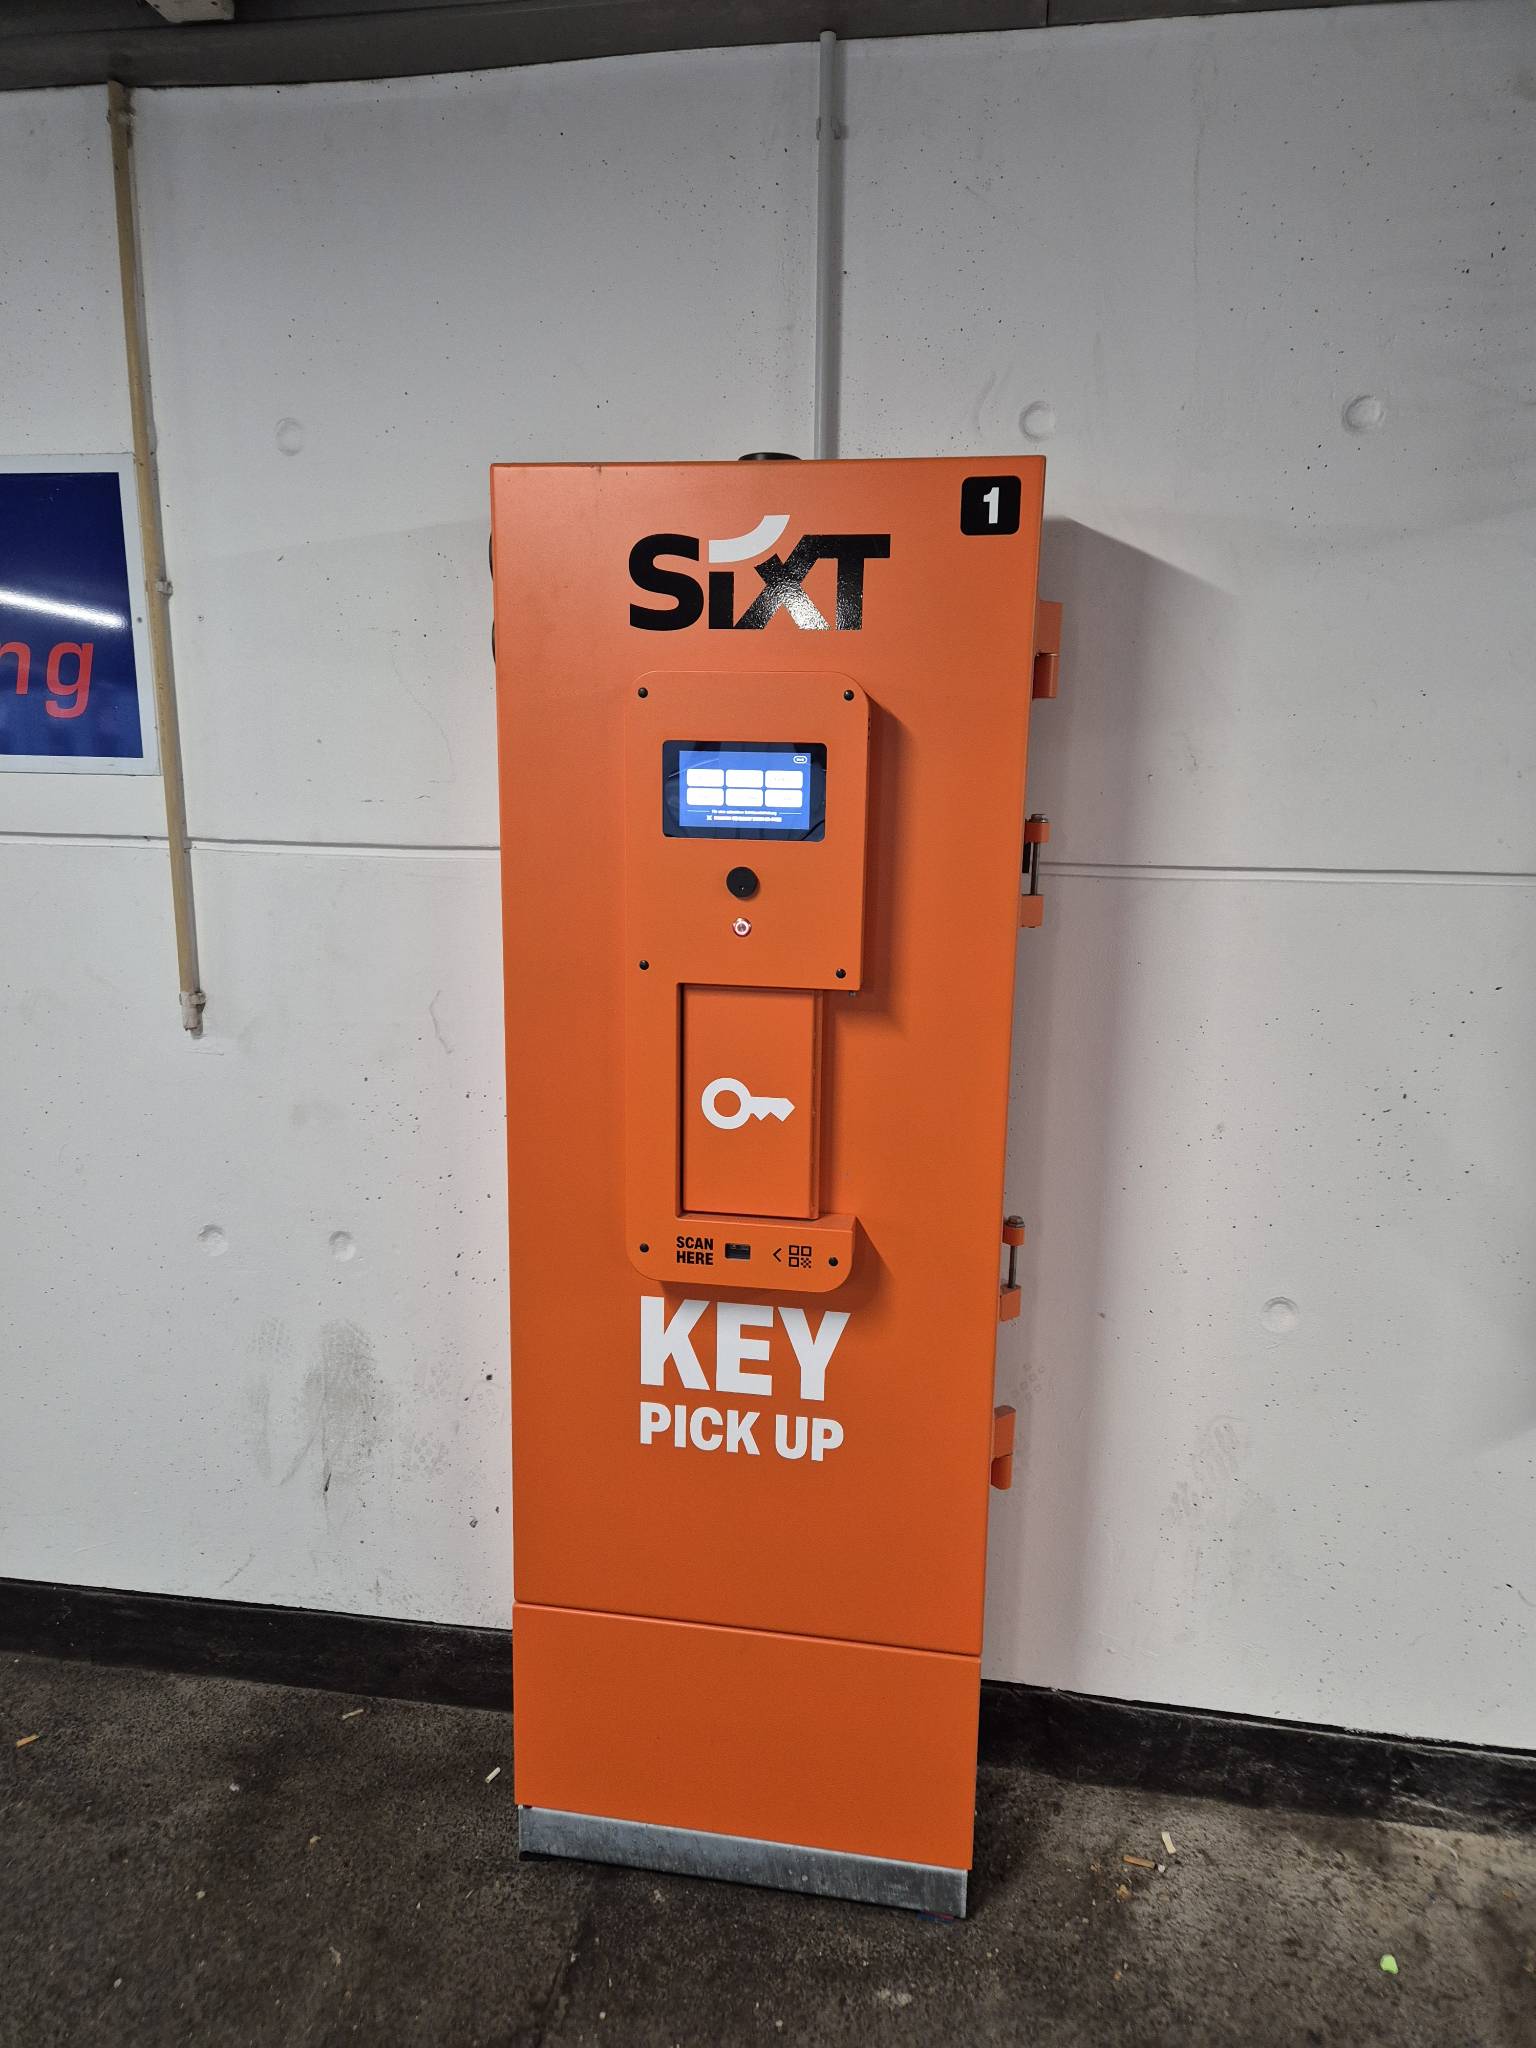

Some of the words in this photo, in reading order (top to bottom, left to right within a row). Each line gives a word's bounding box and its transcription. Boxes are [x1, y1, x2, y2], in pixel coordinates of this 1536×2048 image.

[982, 486, 1000, 525] 1
[676, 1236, 714, 1250] SCAN
[676, 1251, 714, 1266] HERE
[640, 1295, 851, 1401] KEY
[640, 1401, 761, 1456] PICK
[775, 1414, 845, 1462] UP
